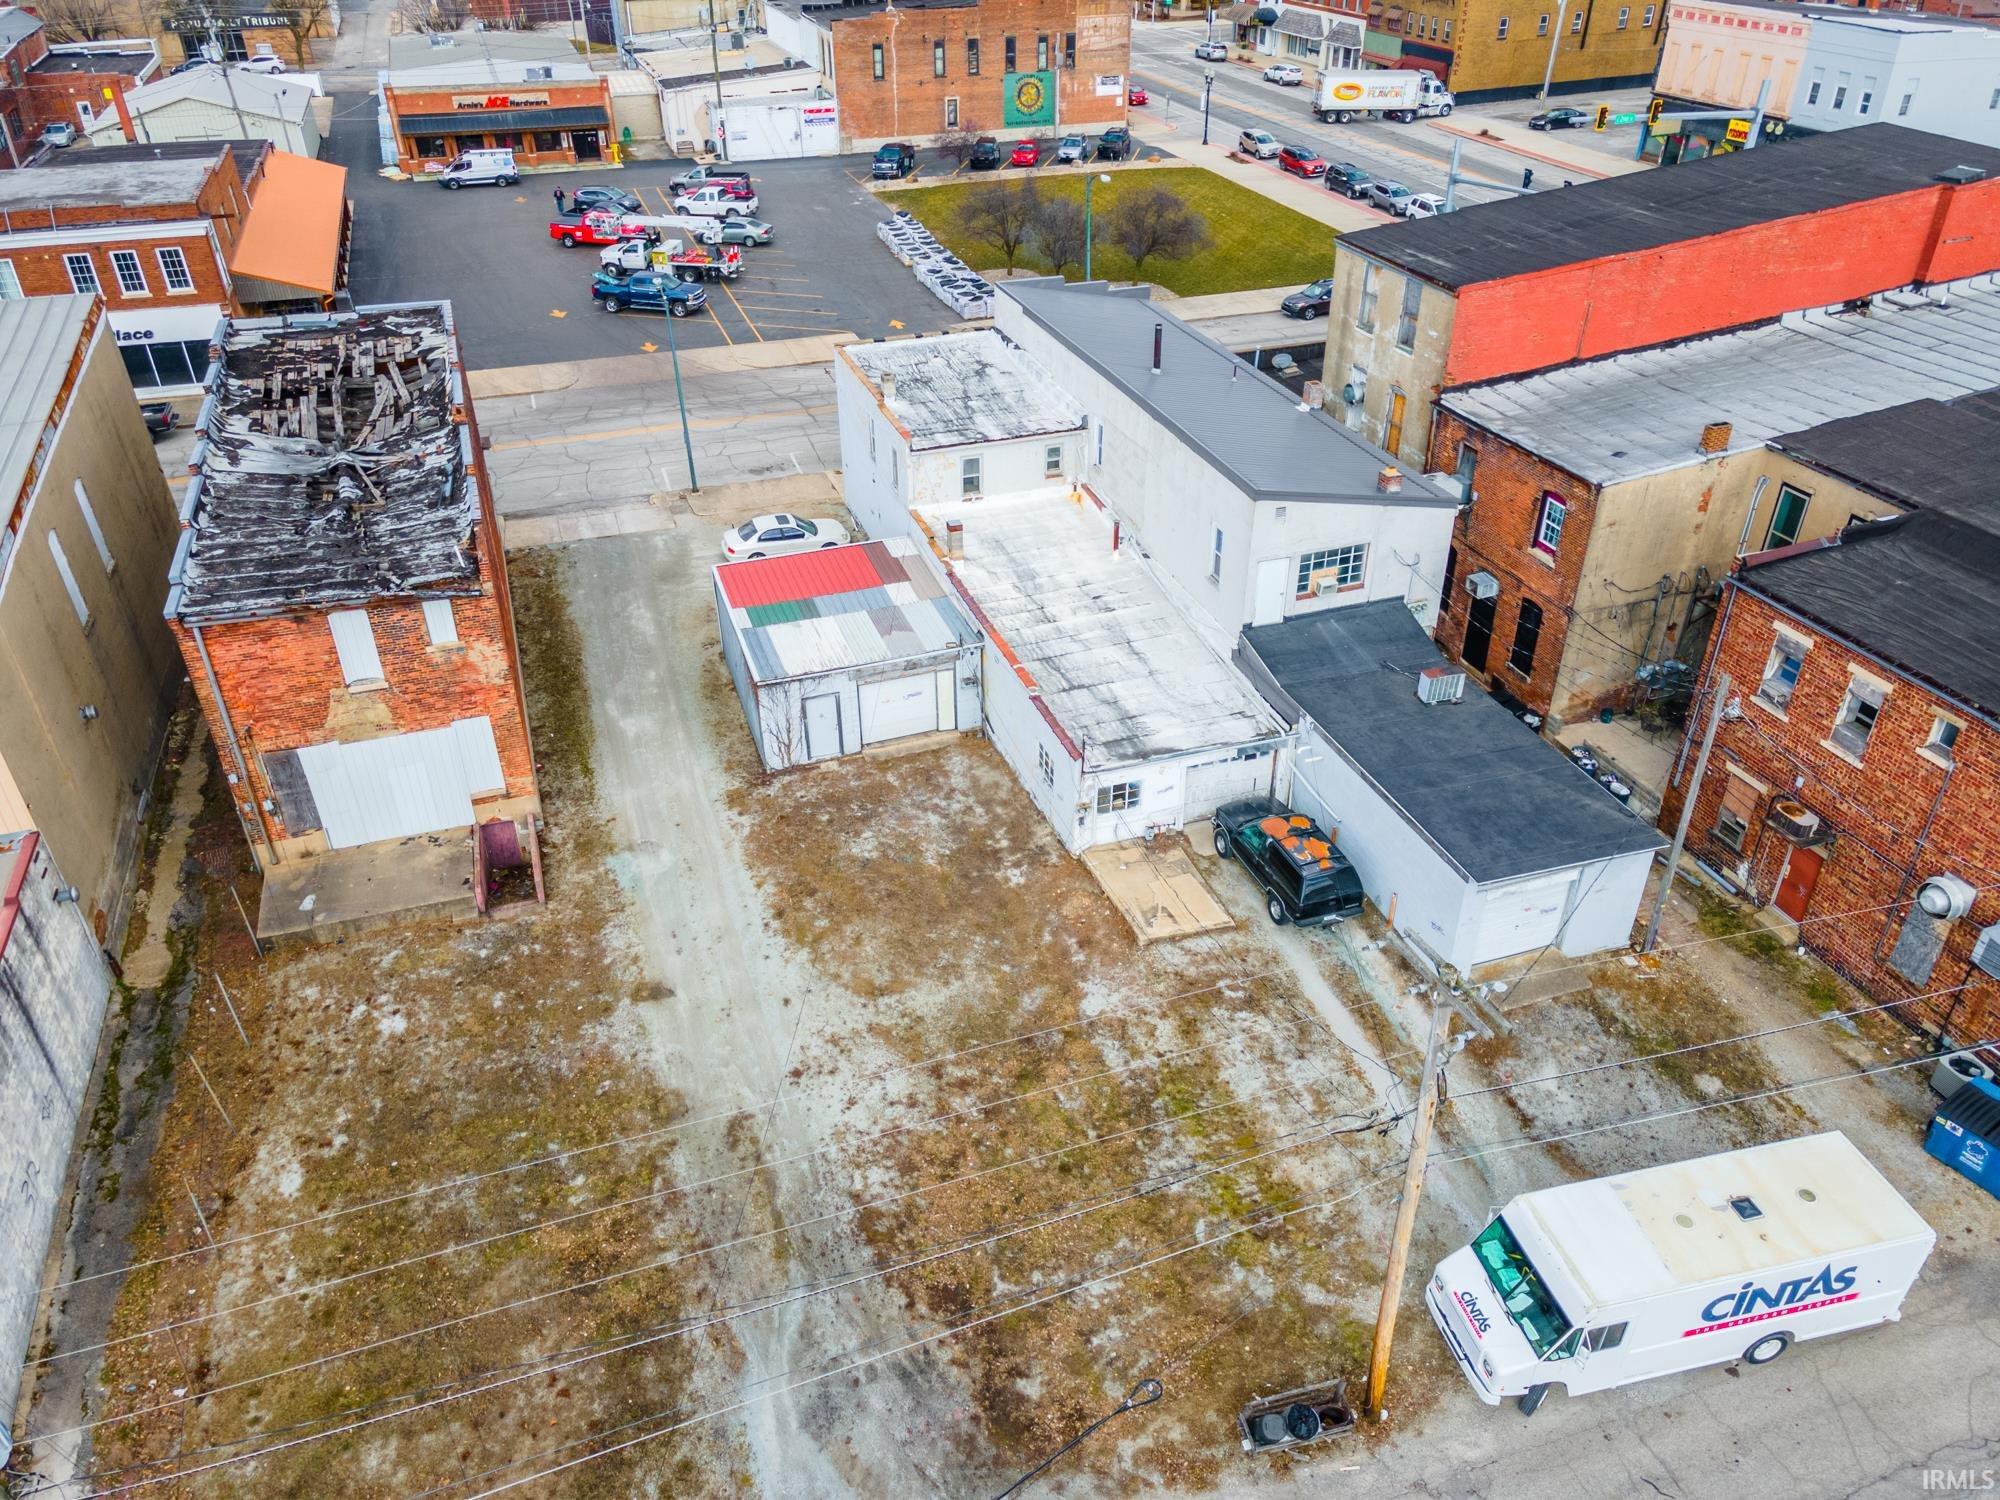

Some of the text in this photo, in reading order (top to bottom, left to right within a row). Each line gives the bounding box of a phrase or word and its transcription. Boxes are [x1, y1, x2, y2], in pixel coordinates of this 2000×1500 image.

[204, 17, 241, 28] ALY
[242, 16, 290, 27] TRIBUNE
[1367, 89, 1403, 98] FLAVOR
[457, 95, 548, 109] Arnie's ACE Hardware
[114, 329, 154, 342] lace
[1694, 1296, 1847, 1333] THE UNIFORM PEOPLE
